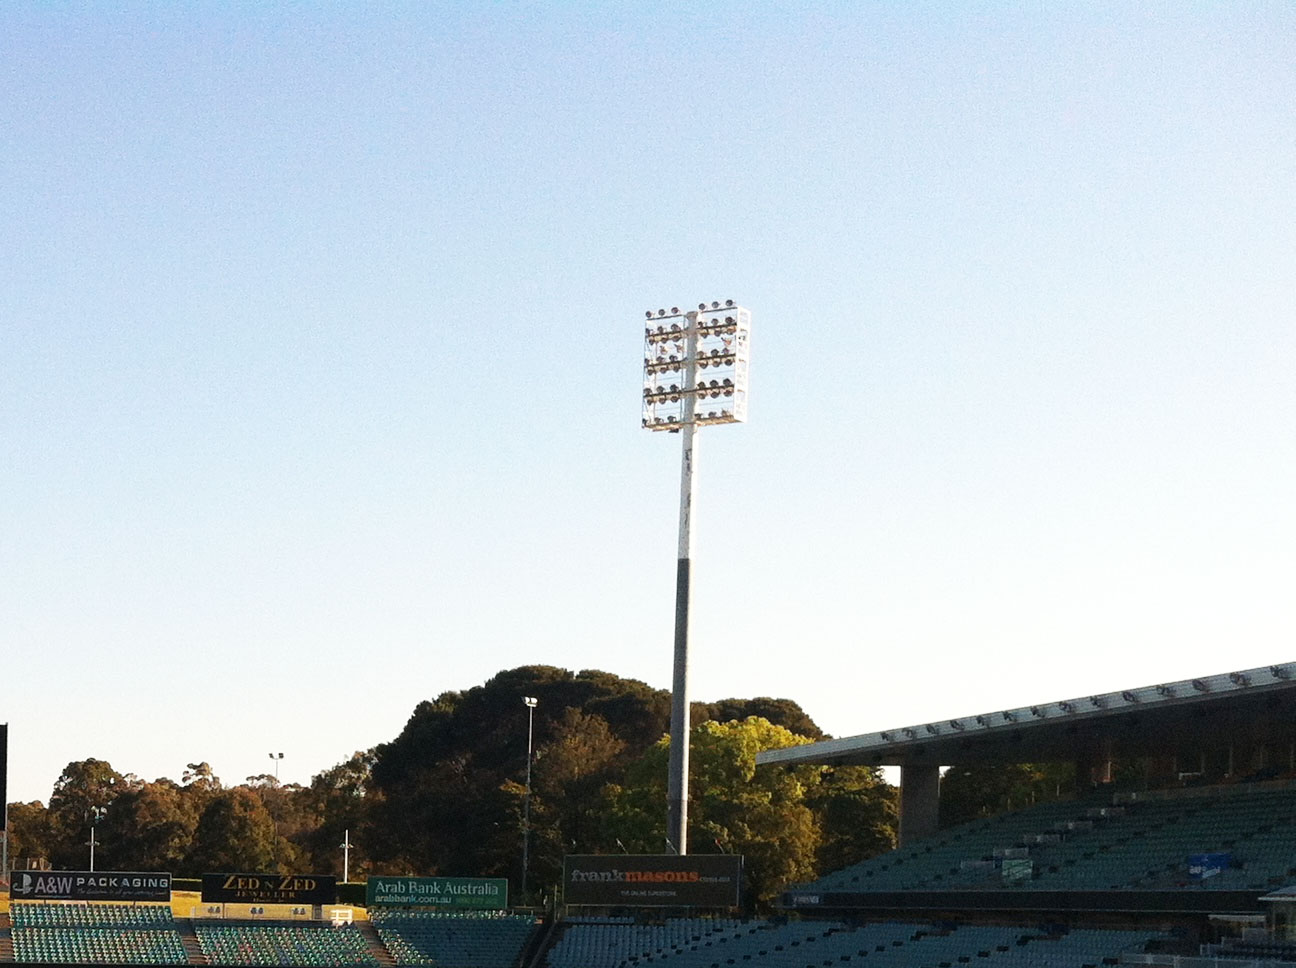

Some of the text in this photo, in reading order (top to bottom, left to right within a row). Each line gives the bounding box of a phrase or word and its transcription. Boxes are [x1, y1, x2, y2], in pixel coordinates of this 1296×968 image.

[34, 877, 73, 894] A&W
[76, 878, 169, 888] PACKAGING
[223, 875, 260, 890] ZED
[279, 876, 316, 891] ZED
[375, 881, 499, 895] Arab Bank Australia
[375, 894, 452, 904] arabbank.com.au
